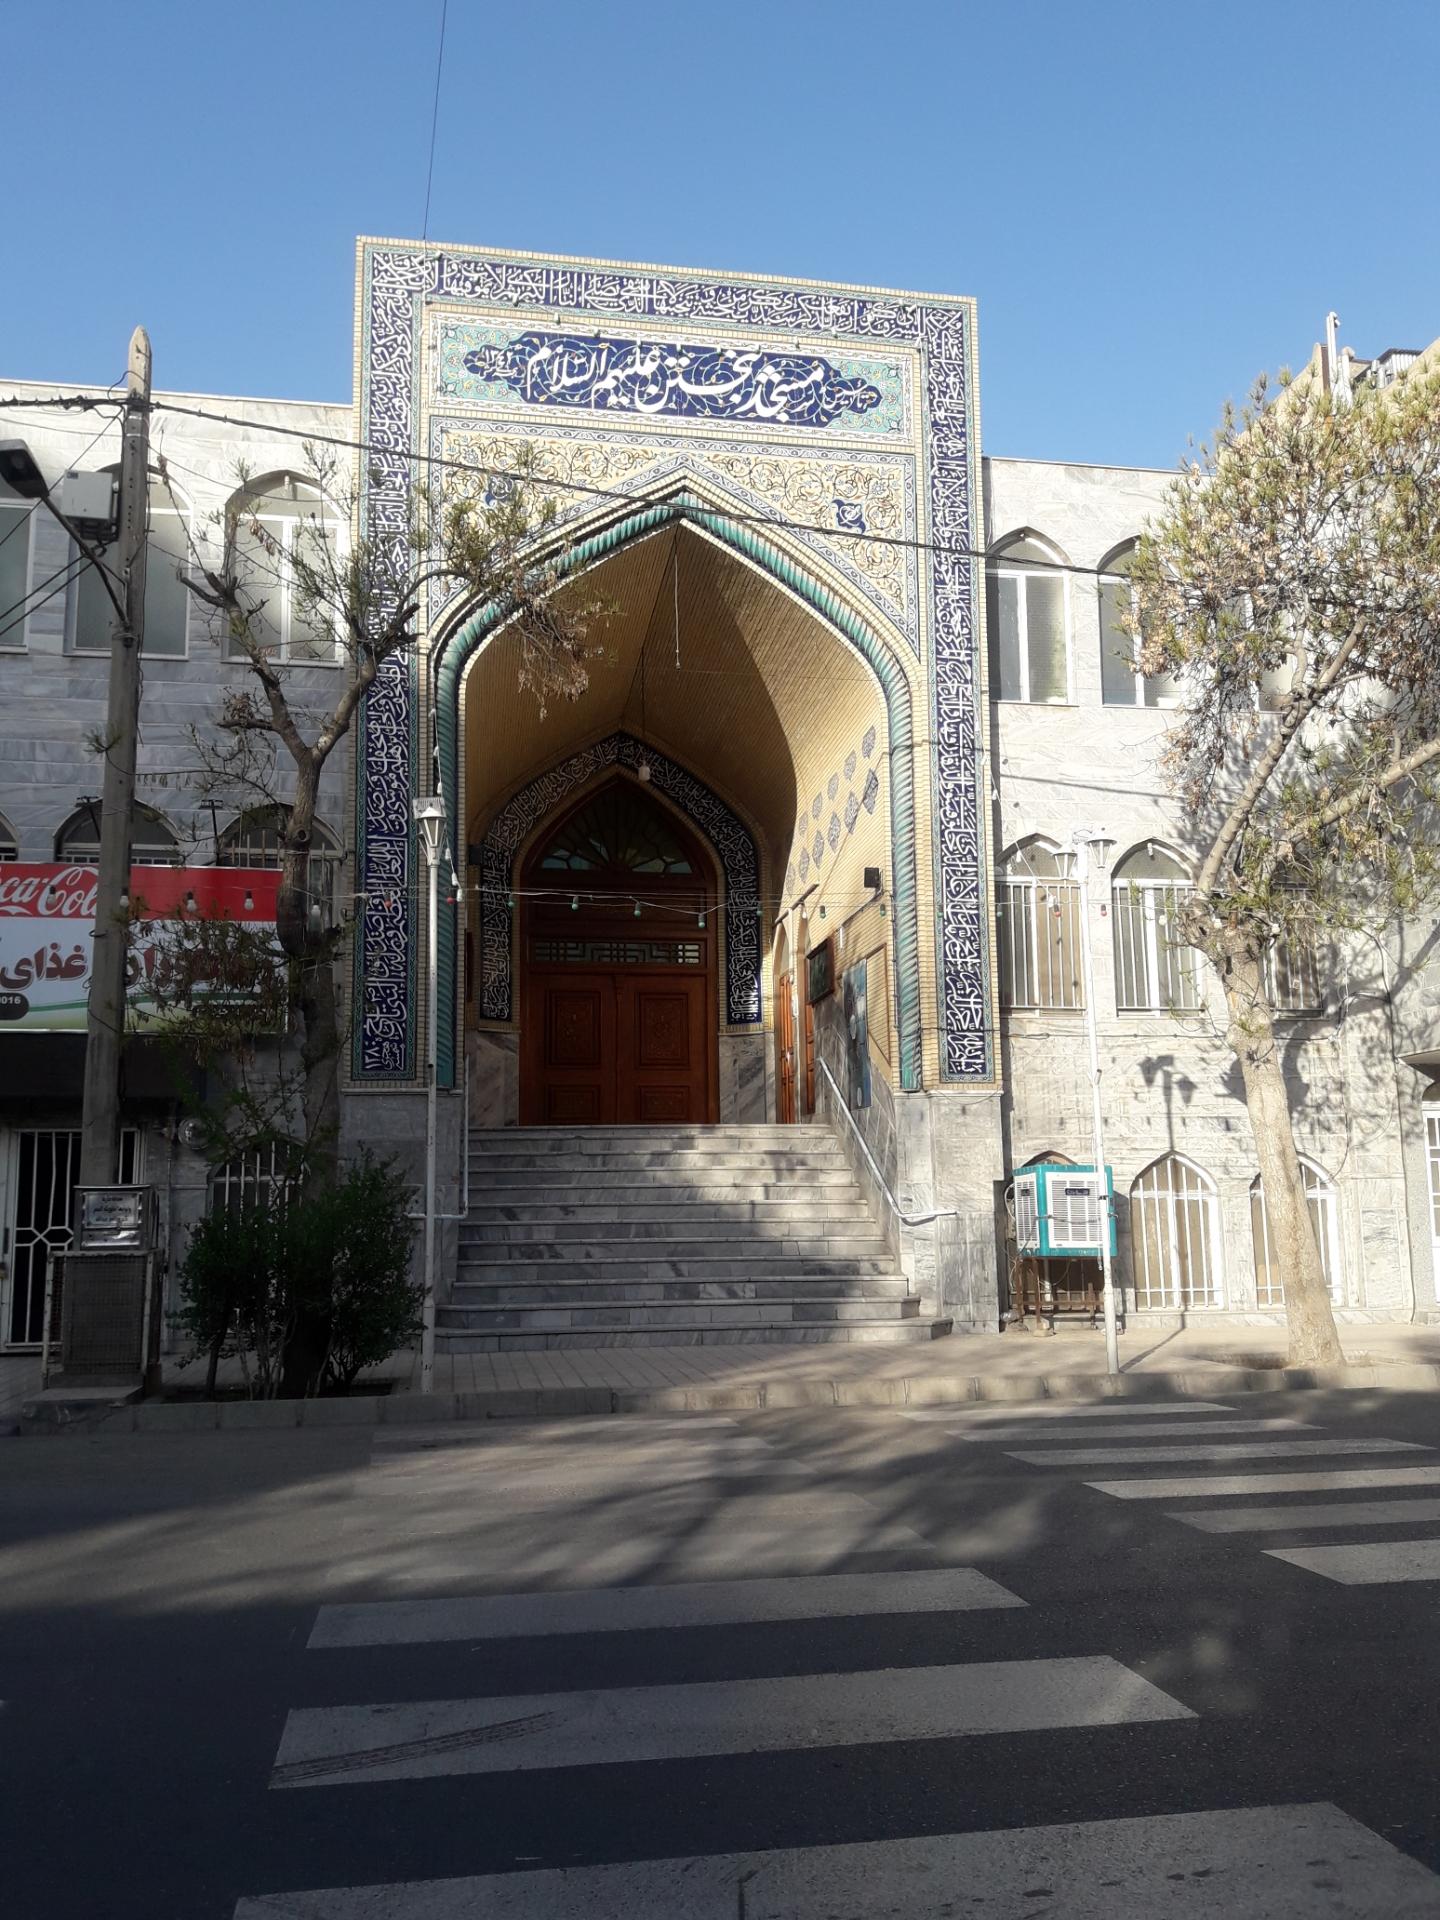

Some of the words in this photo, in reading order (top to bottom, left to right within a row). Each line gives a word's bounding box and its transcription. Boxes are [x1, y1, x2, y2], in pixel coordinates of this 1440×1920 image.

[527, 346, 608, 399] السلام
[592, 343, 661, 410] علیهم
[733, 365, 825, 422] مسجد
